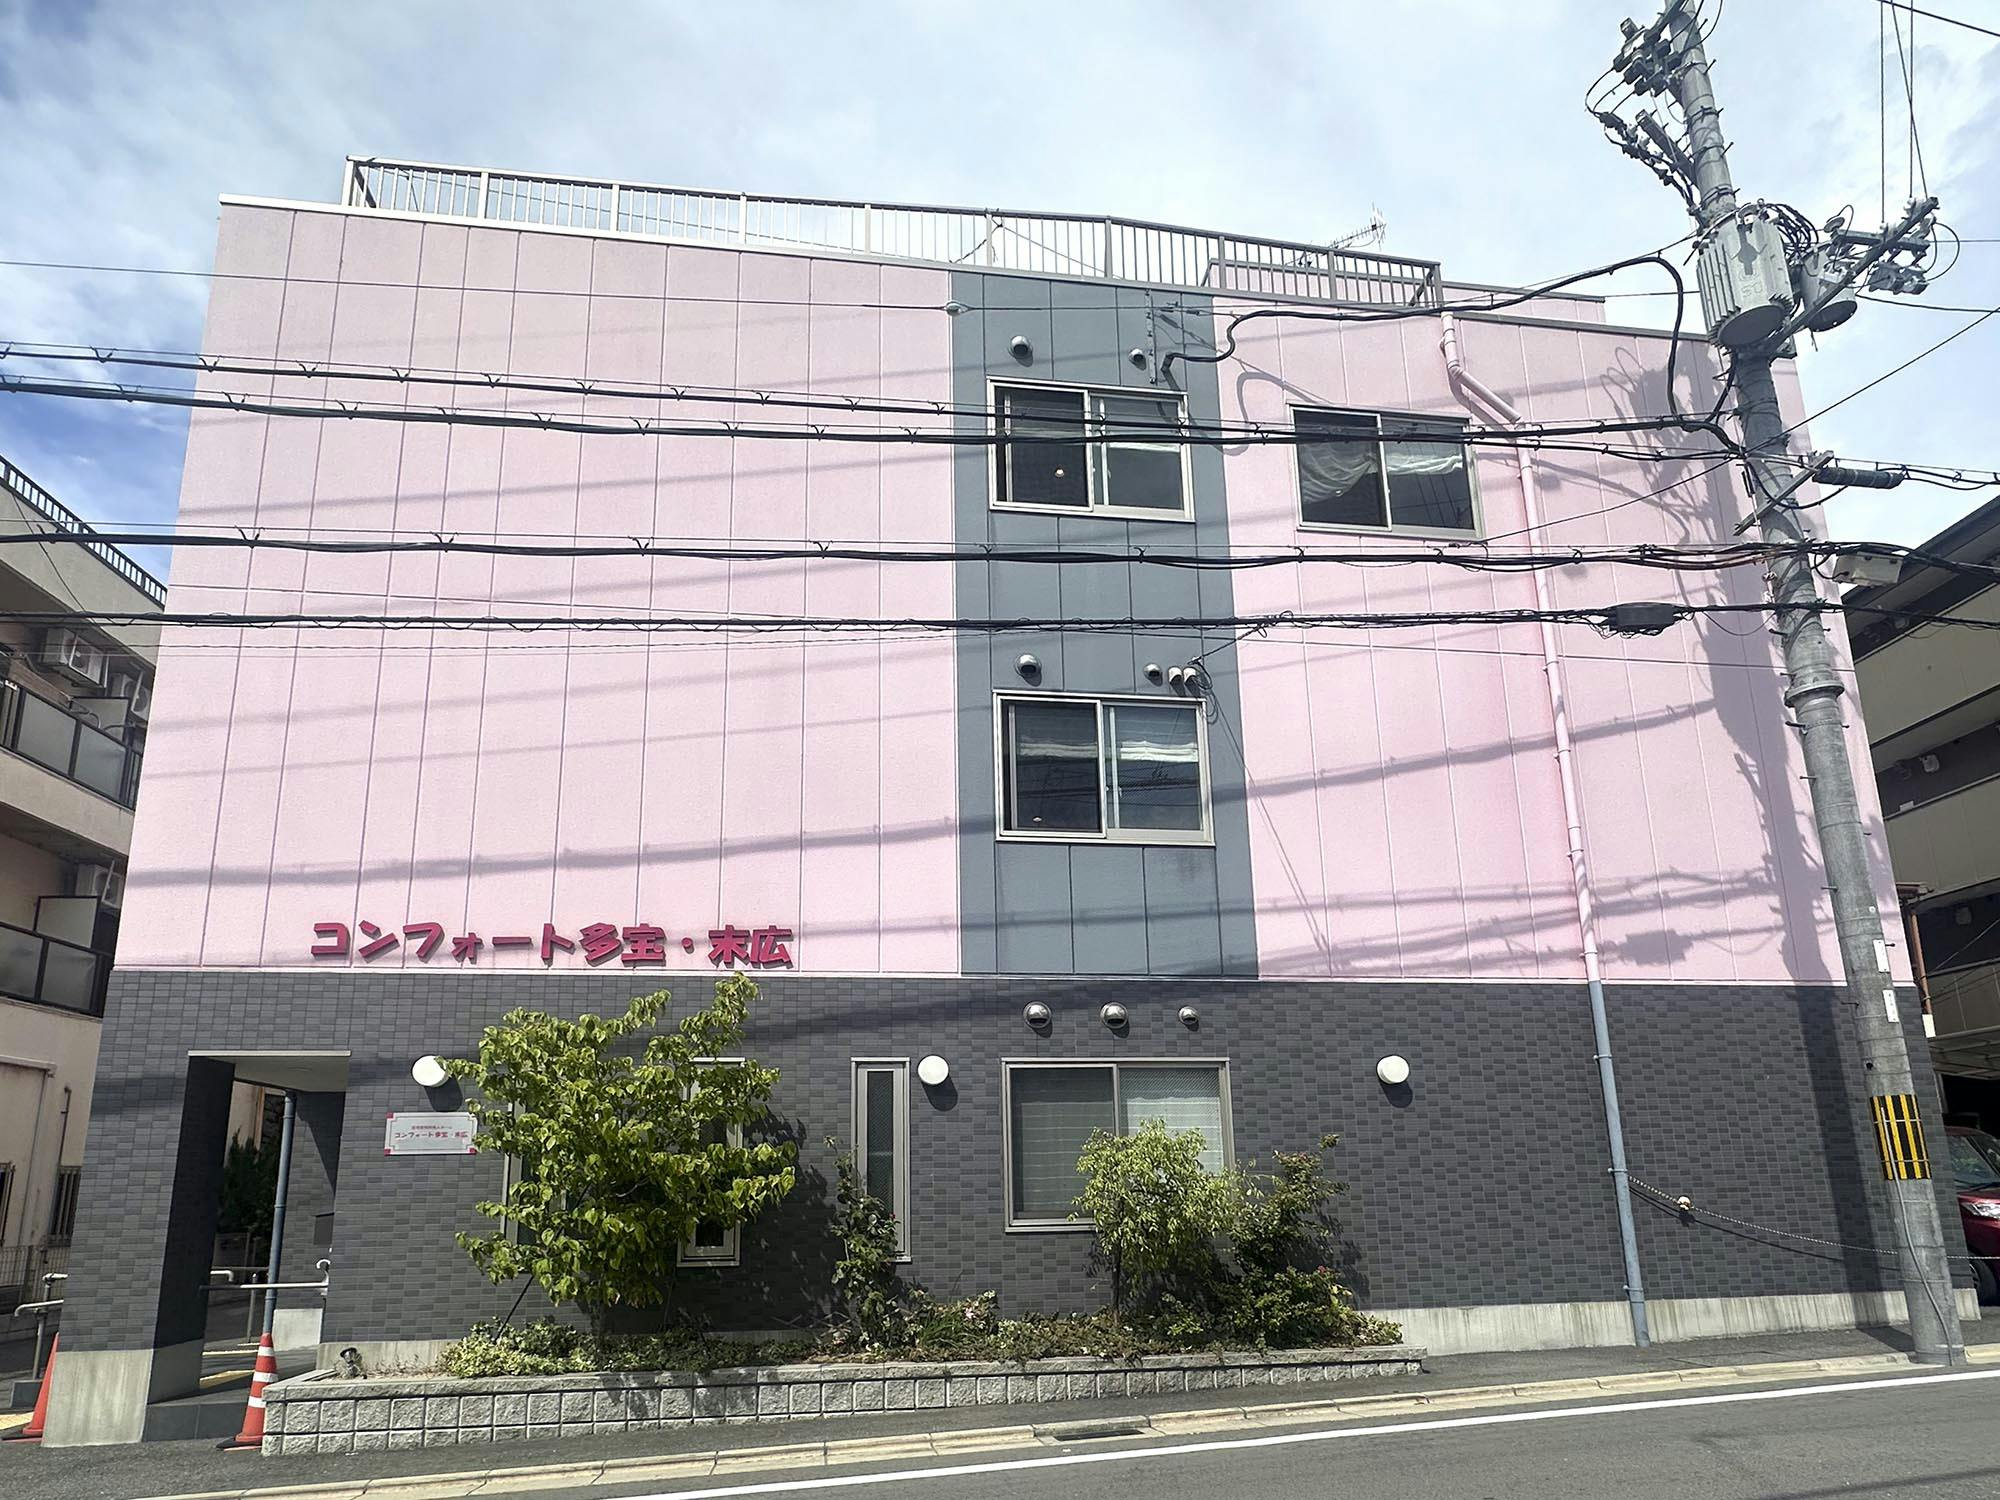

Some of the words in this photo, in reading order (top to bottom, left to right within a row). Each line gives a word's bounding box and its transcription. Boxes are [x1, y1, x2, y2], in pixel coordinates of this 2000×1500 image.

[311, 919, 793, 967] コンフォート多宝・末広
